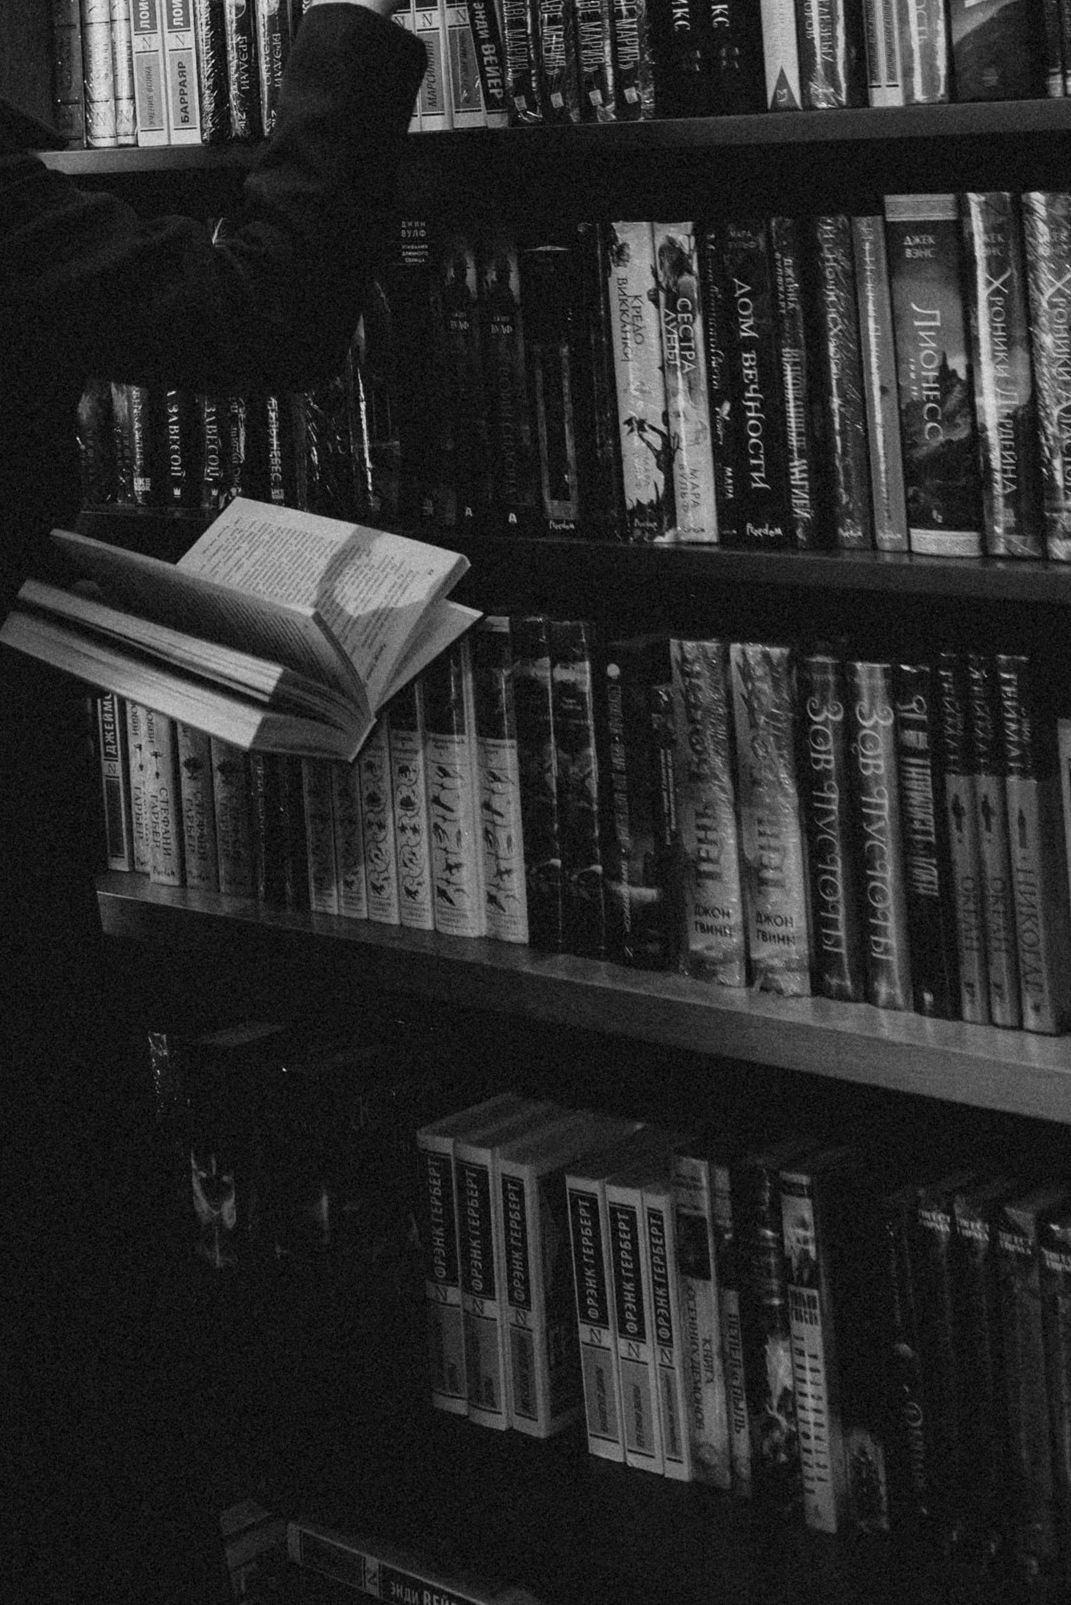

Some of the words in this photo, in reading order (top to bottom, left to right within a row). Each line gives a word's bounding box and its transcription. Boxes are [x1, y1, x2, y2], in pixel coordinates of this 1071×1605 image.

[176, 60, 190, 123] БАРРАЯР
[481, 44, 505, 100] ВЕЙЕР
[615, 276, 630, 363] ВИККАНКИ
[630, 294, 645, 346] КРЕДО
[676, 297, 697, 374] СЕСТРА
[732, 278, 759, 339] ДОМ
[982, 267, 1013, 379] ХРОНИКИ
[740, 350, 772, 491] ВЕЧНОСТИ
[806, 696, 845, 772] ЗОВ
[850, 700, 895, 777] ЗОВ
[150, 794, 161, 849] ГАРБЕР
[159, 787, 172, 857] СТЕФАНИ
[812, 779, 847, 954] ПУСТОТЫ
[860, 783, 896, 961] ПУСТОТЫ
[695, 905, 731, 922] ДЖОН
[756, 912, 795, 929] ДЖОН
[960, 876, 979, 952] ОКЕАН
[1015, 868, 1046, 994] НИКОГДЕ
[426, 1157, 442, 1224] ГЕРБЕРТ
[465, 1169, 480, 1235] ГЕРБЕРТ
[506, 1183, 522, 1247] ГЕРБЕРТ
[432, 1228, 447, 1279] ФРЭНК
[577, 1198, 594, 1263] ГЕРБЕРТ
[616, 1210, 633, 1277] ГЕРБЕРТ
[649, 1217, 666, 1283] ГЕРБЕРТ
[469, 1239, 485, 1292] ФРЭНК
[511, 1251, 526, 1302] ФРЭНК
[585, 1267, 601, 1319] ФРЭНК
[622, 1281, 639, 1333] ФРЭНК
[655, 1287, 671, 1339] ФРЭНК
